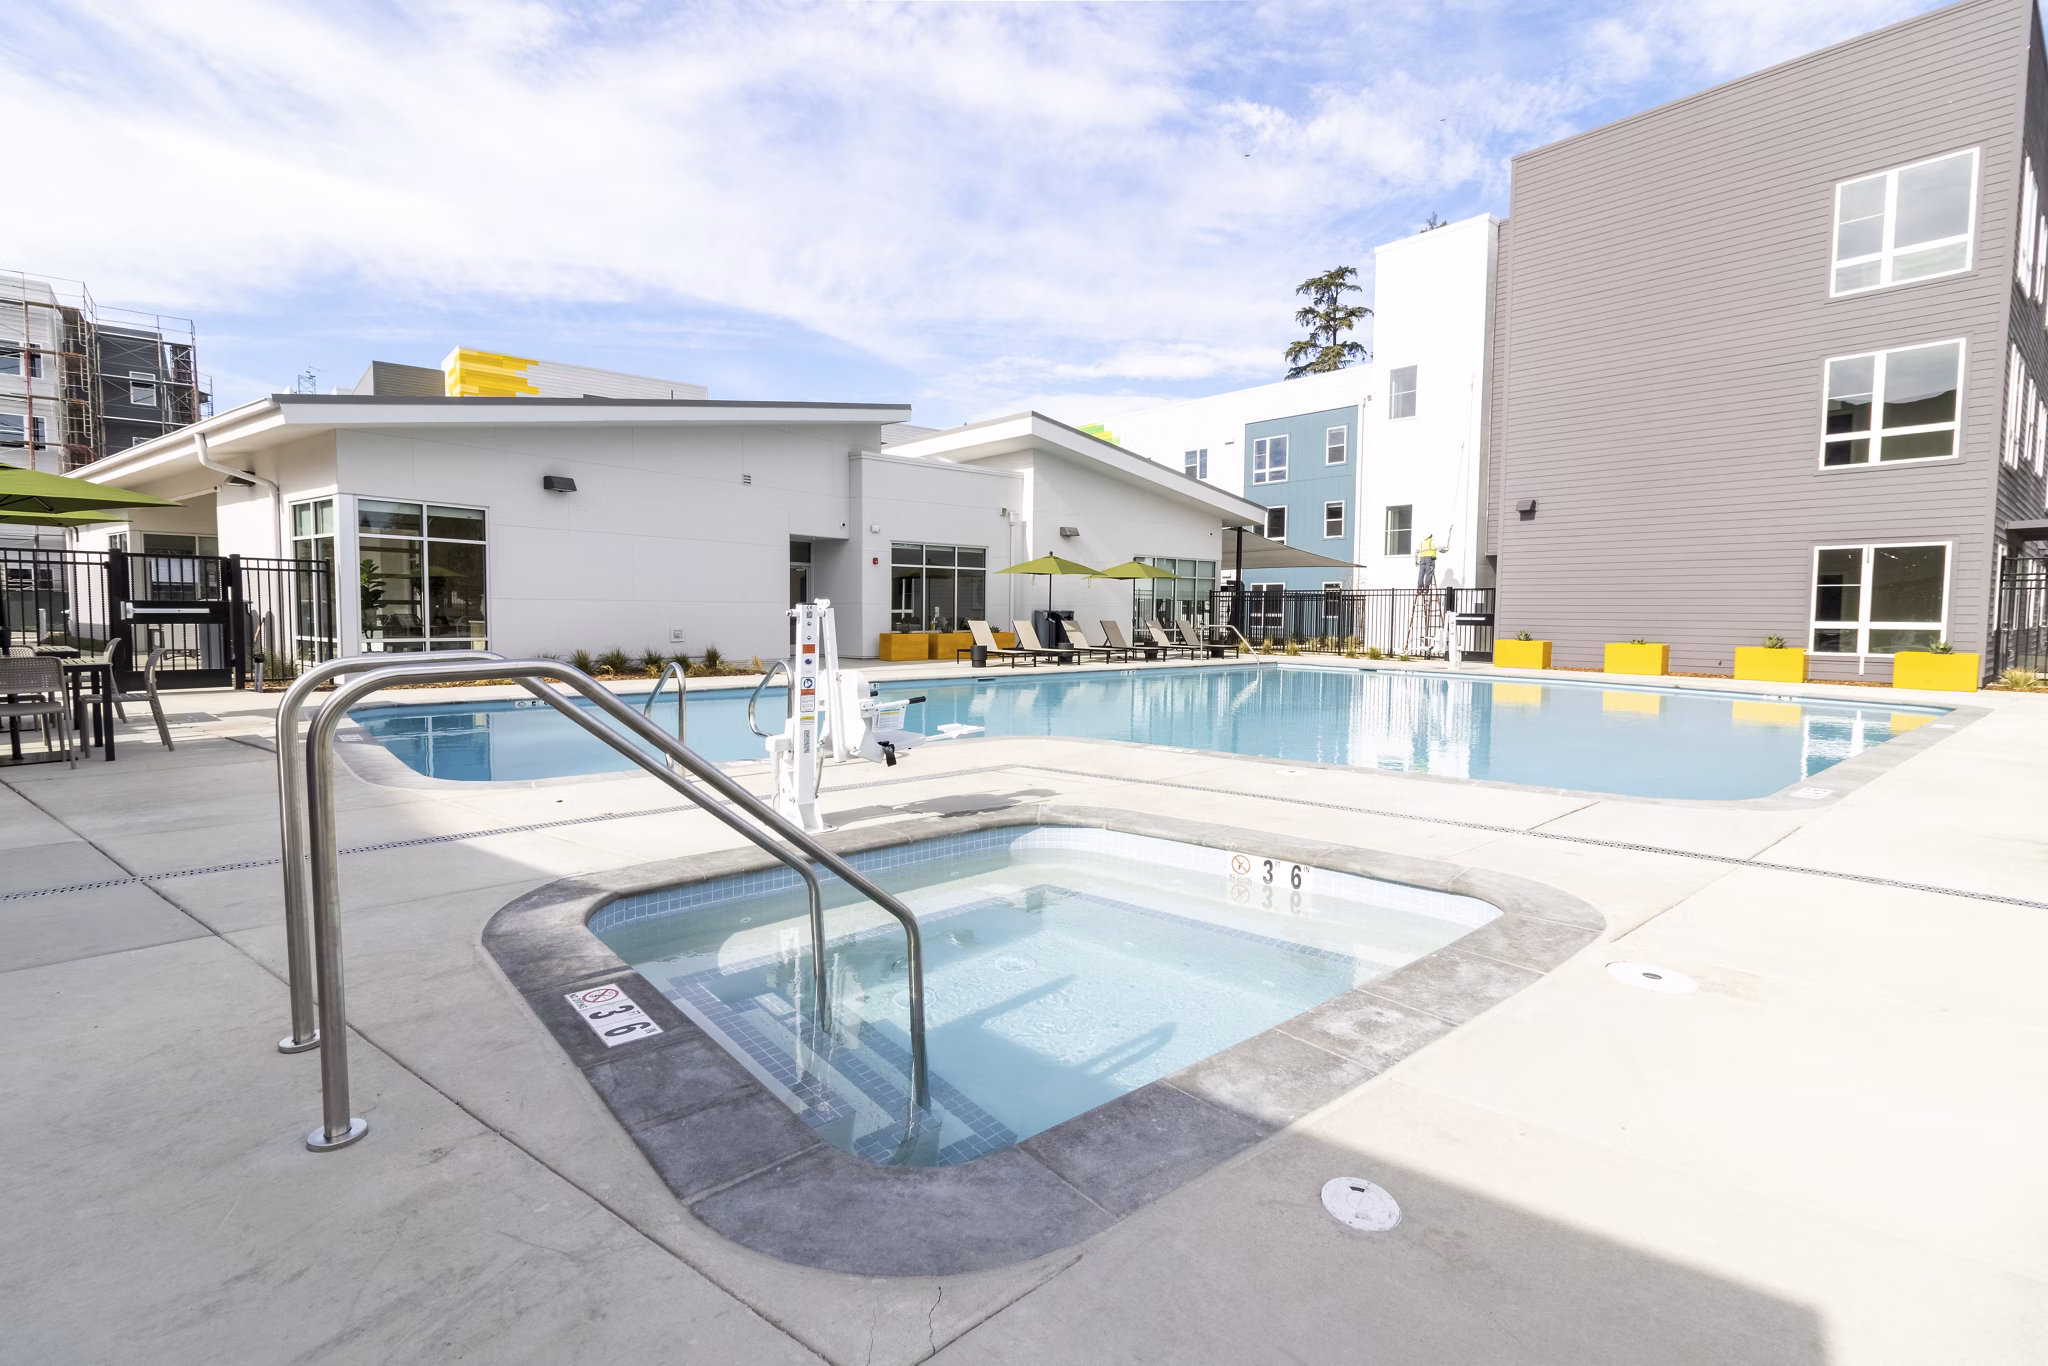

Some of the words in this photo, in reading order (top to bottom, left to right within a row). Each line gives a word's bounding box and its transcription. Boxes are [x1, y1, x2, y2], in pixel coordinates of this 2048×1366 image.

[1262, 859, 1273, 885] 3
[1291, 864, 1302, 890] 6
[589, 1005, 634, 1019] 3
[604, 1022, 651, 1036] 6
